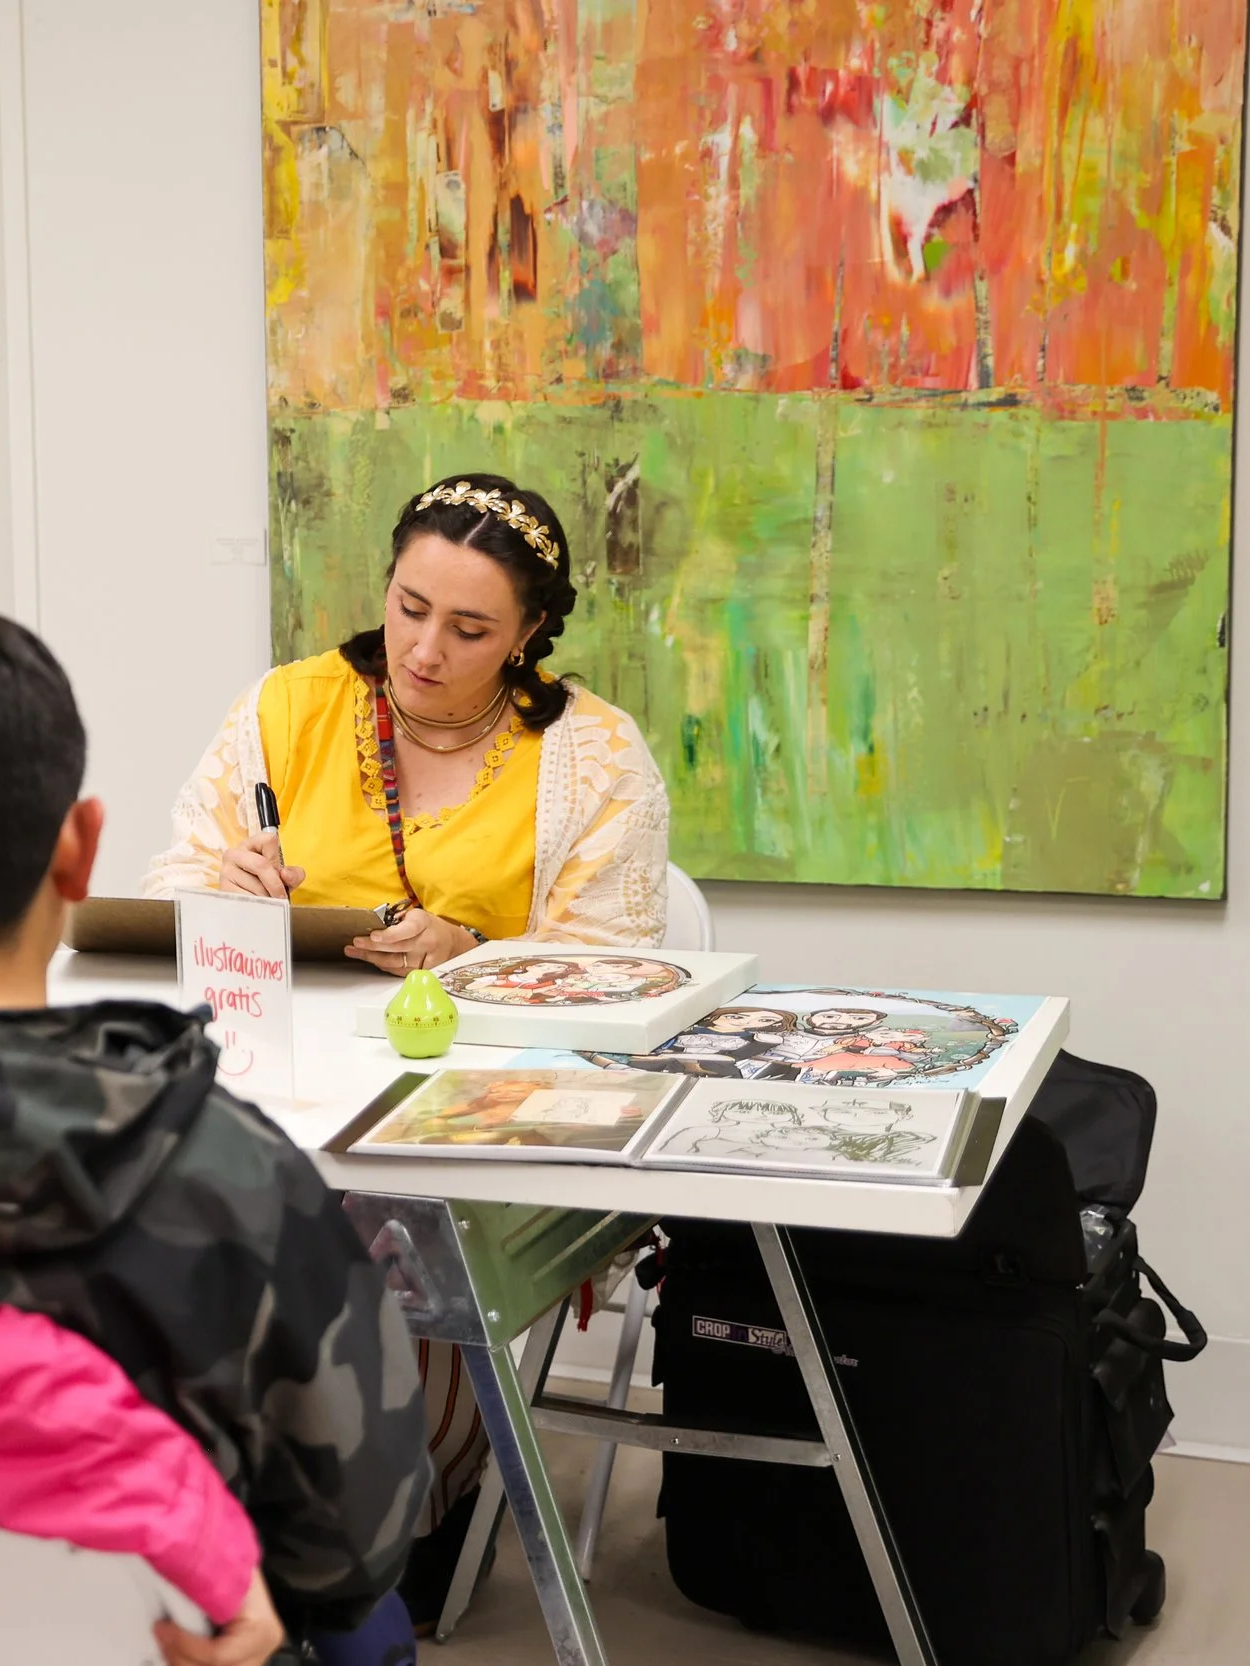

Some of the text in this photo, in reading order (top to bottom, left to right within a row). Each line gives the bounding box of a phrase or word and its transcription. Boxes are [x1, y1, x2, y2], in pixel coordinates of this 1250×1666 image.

[204, 986, 262, 1022] gratis
[696, 1319, 731, 1338] CROP
[751, 1328, 786, 1348] Style
